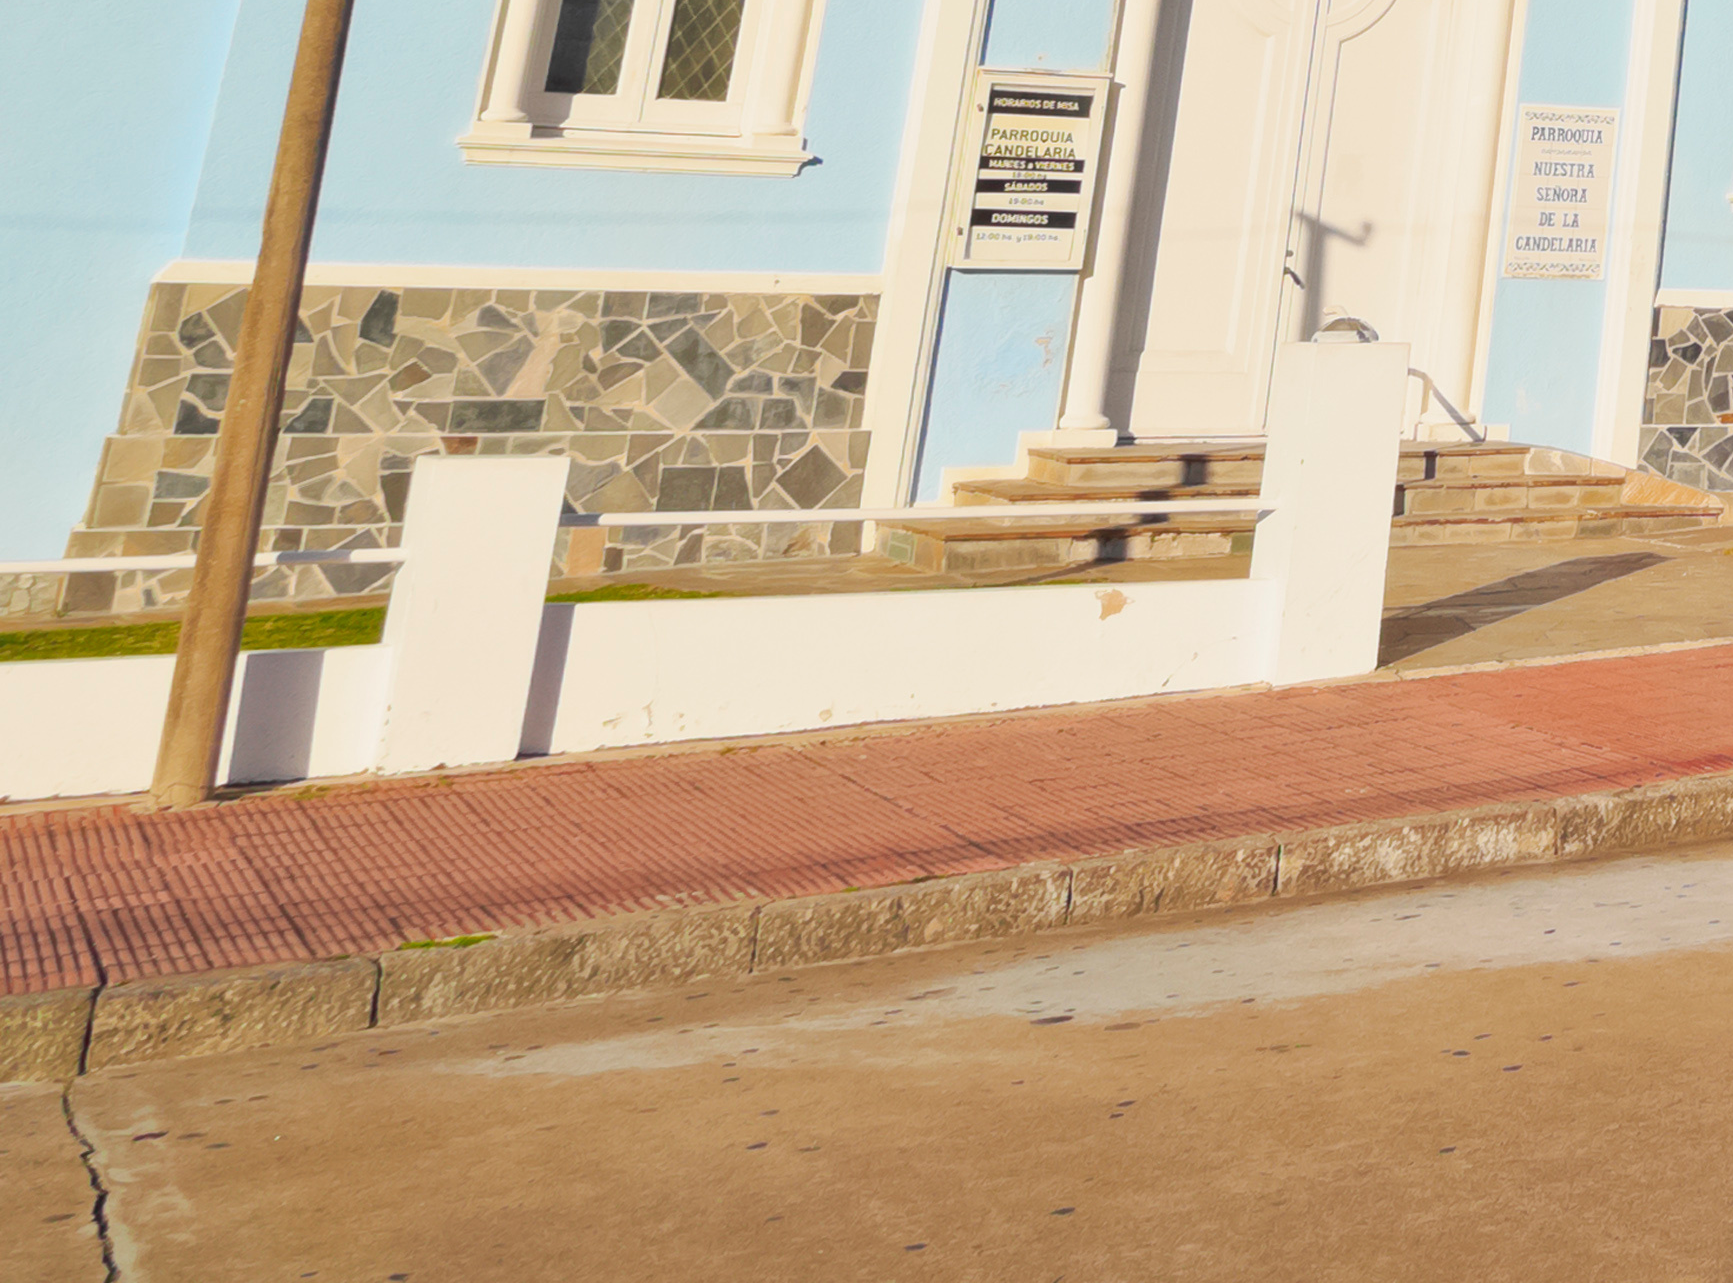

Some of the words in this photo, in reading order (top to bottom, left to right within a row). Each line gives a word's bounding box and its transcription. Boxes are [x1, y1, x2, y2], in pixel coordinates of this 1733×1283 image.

[993, 97, 1042, 109] HORARIOS
[1042, 99, 1056, 110] DE
[991, 128, 1074, 144] PARROQUIA
[1531, 126, 1603, 144] PARROQUIA
[985, 143, 1076, 158] CANDELARIA
[1533, 161, 1595, 178] NUESTRA
[1004, 181, 1048, 192] SÁBADOS
[1536, 185, 1588, 203] SEÑORA
[991, 213, 1049, 225] DOMINGOS
[1538, 212, 1556, 227] DE
[1562, 213, 1579, 228] LA
[1515, 236, 1597, 253] CANDELARIA
